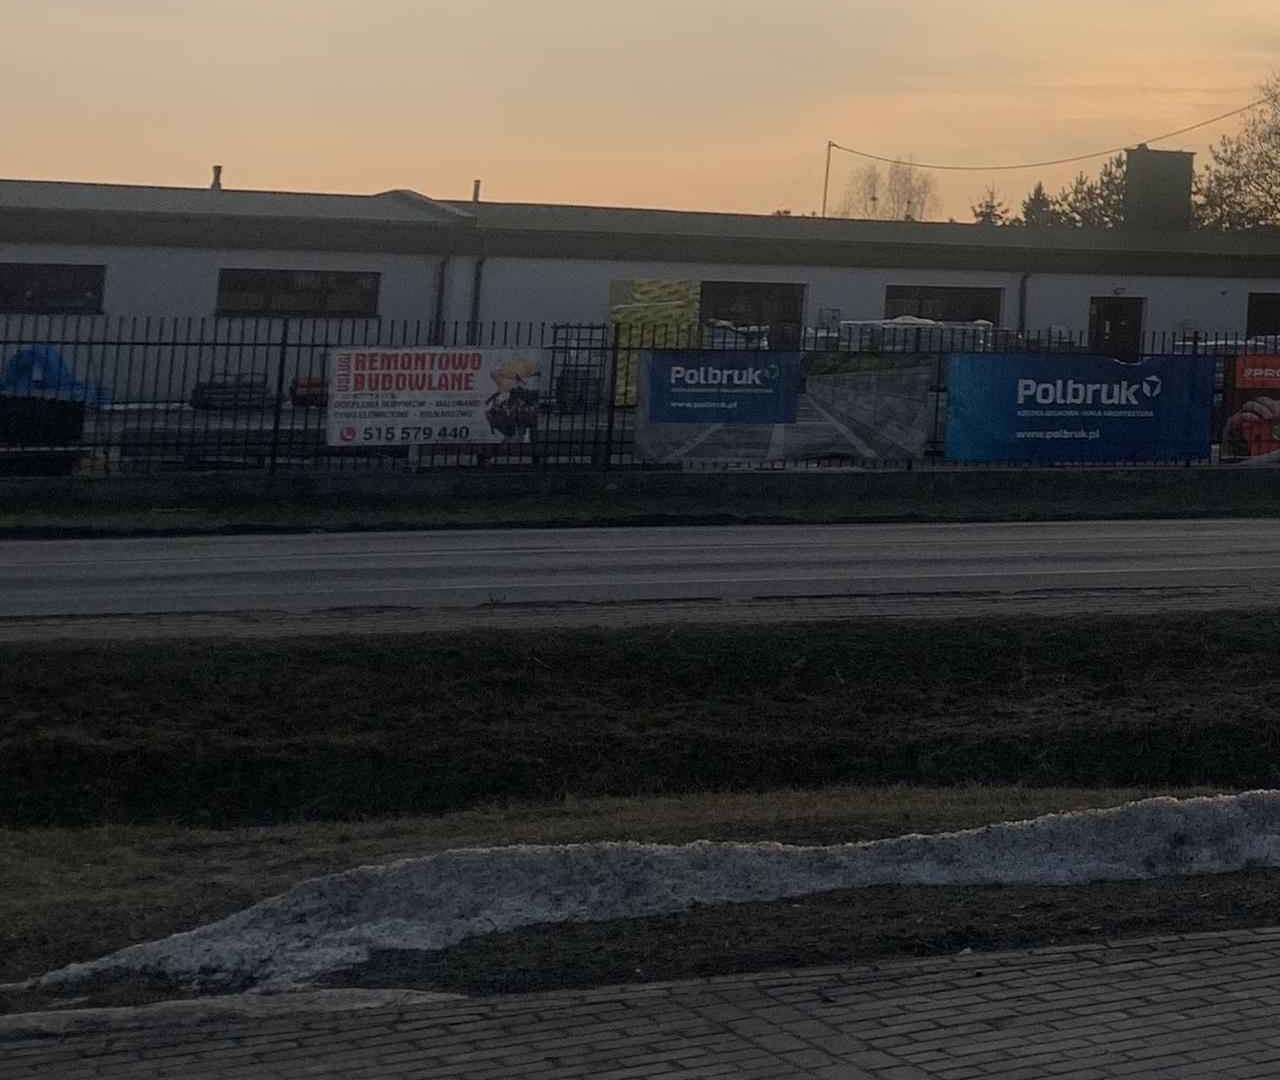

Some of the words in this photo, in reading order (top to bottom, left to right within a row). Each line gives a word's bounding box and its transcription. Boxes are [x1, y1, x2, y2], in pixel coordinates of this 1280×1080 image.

[354, 352, 482, 371] REMONTOWO
[353, 373, 475, 392] BUDOWLANE
[671, 366, 762, 385] Polbruk
[1017, 379, 1140, 405] Polbruk
[362, 426, 395, 441] 515
[401, 426, 433, 441] 579
[437, 425, 470, 440] 440
